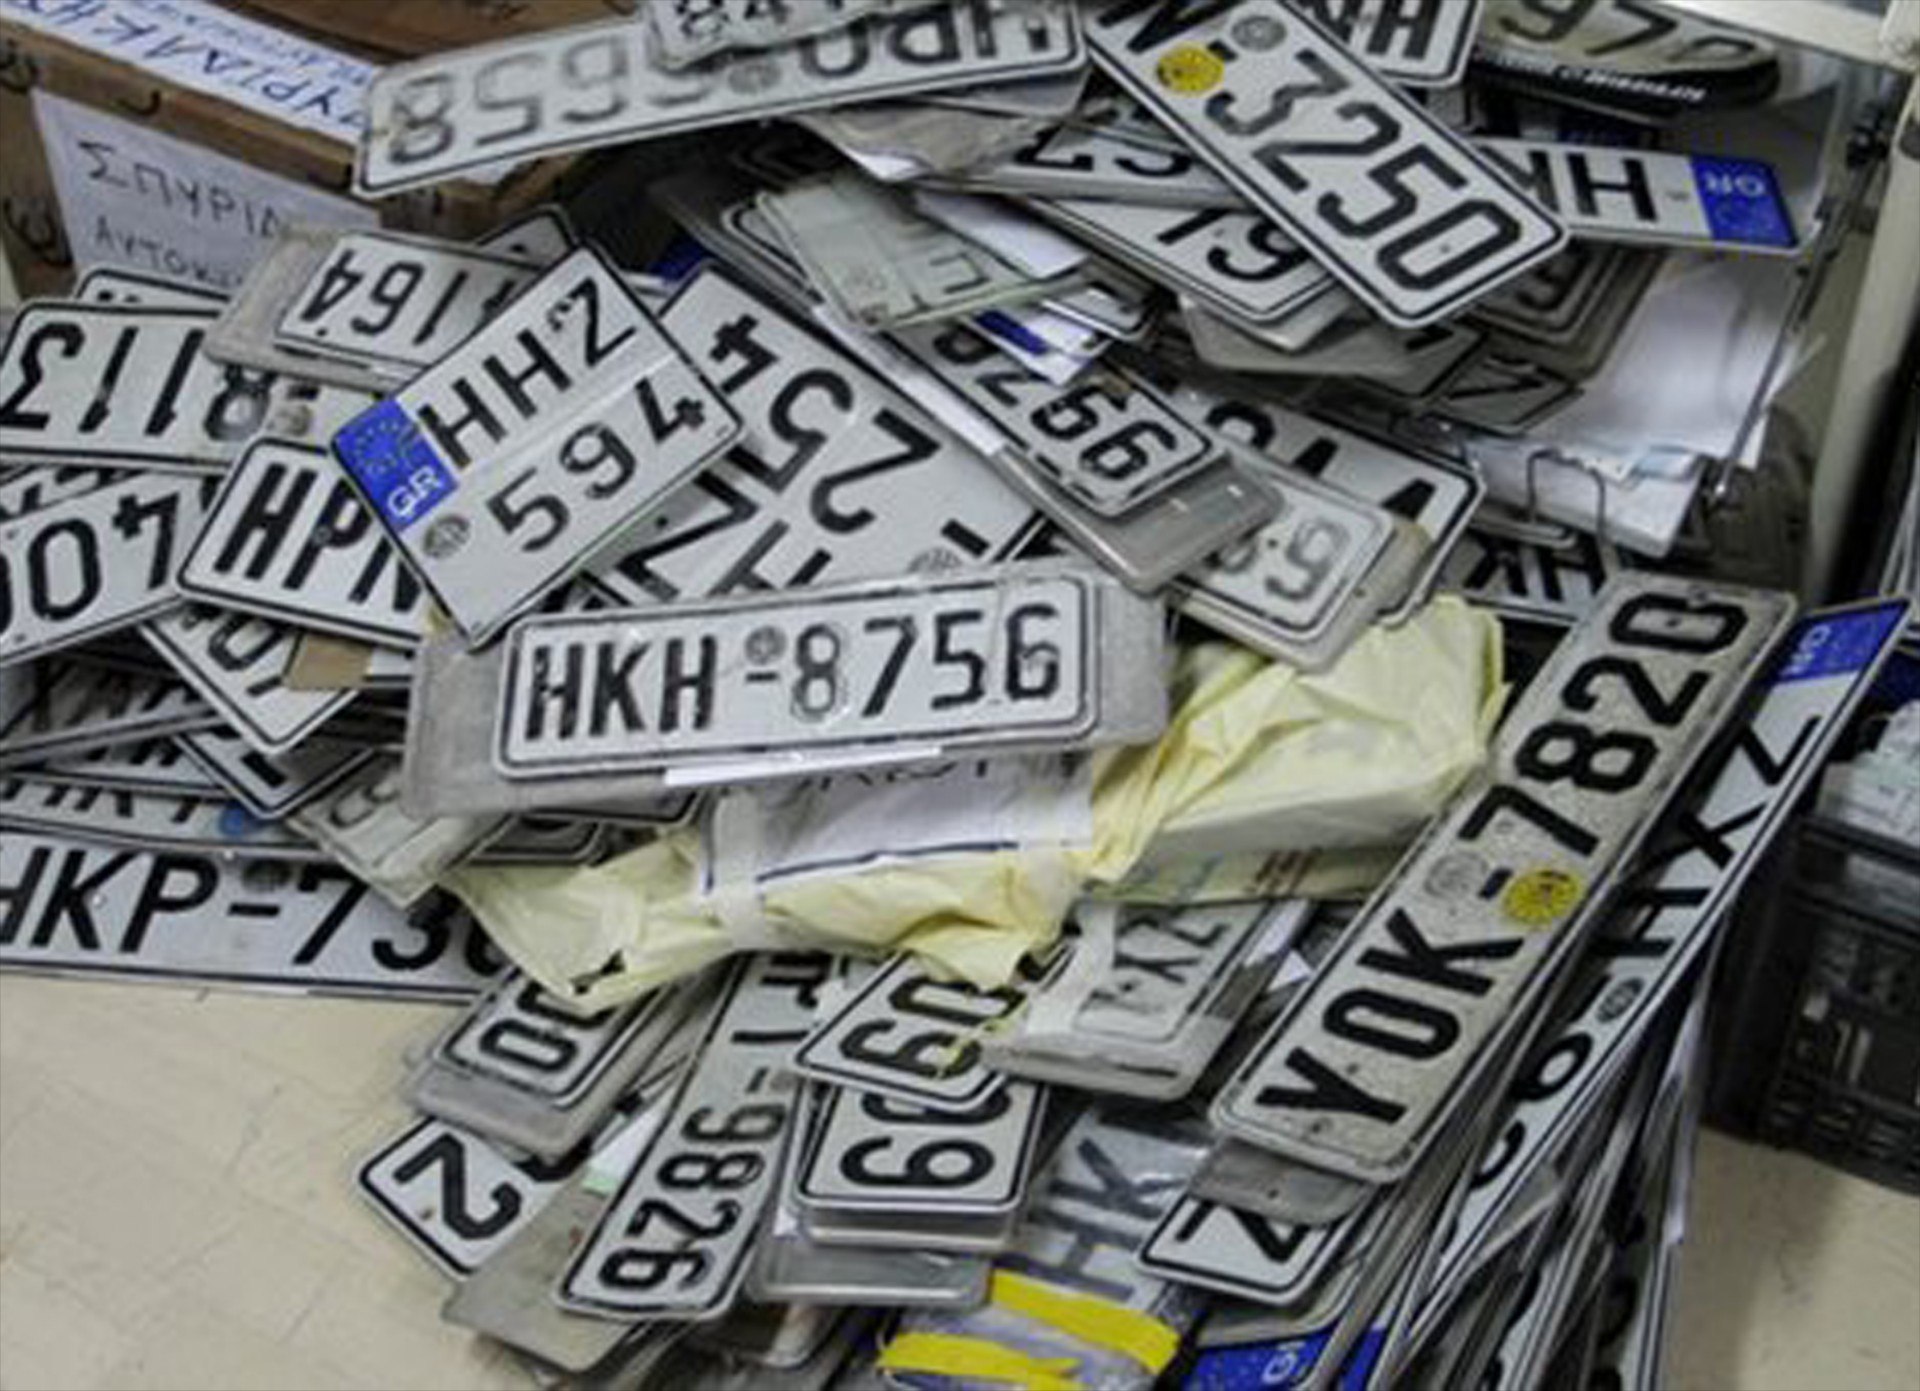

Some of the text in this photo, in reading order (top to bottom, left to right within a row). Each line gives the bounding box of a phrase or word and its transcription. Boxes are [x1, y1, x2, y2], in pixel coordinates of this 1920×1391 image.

[300, 248, 517, 346] 164
[418, 278, 637, 469] HHZ
[387, 462, 445, 522] GR
[486, 376, 706, 552] 594
[524, 602, 1060, 741] HKH-8756
[1255, 593, 1751, 1125] YOK-7820
